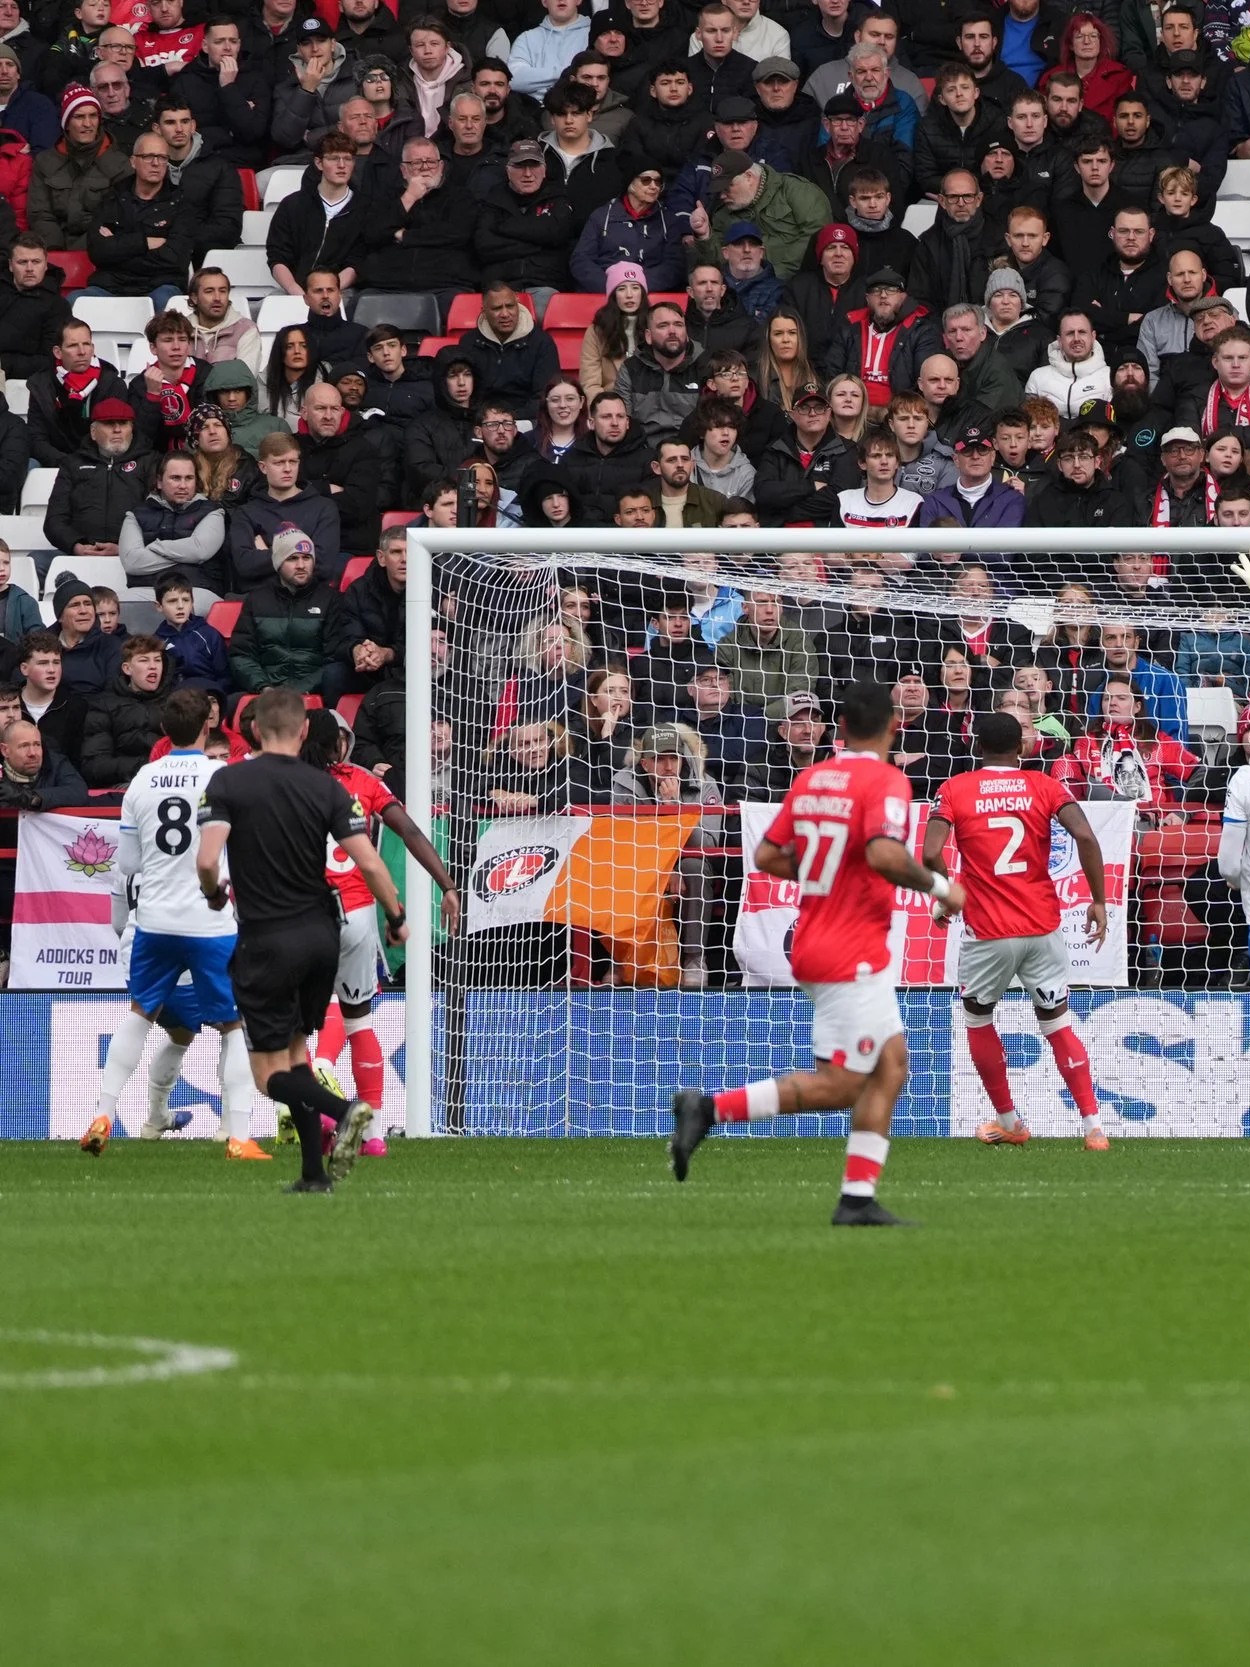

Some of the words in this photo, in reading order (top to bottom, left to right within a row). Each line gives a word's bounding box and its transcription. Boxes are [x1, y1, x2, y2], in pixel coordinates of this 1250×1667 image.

[150, 775, 199, 789] SWIFT
[979, 780, 1016, 788] UNIVERSITY
[980, 785, 1026, 794] GREENWICH
[975, 797, 1033, 813] RAMSAY
[156, 796, 192, 856] 8
[988, 816, 1028, 876] 2
[793, 819, 849, 896] 27
[36, 949, 94, 965] ADDICKS
[99, 949, 118, 965] ON
[58, 971, 93, 986] TOUR
